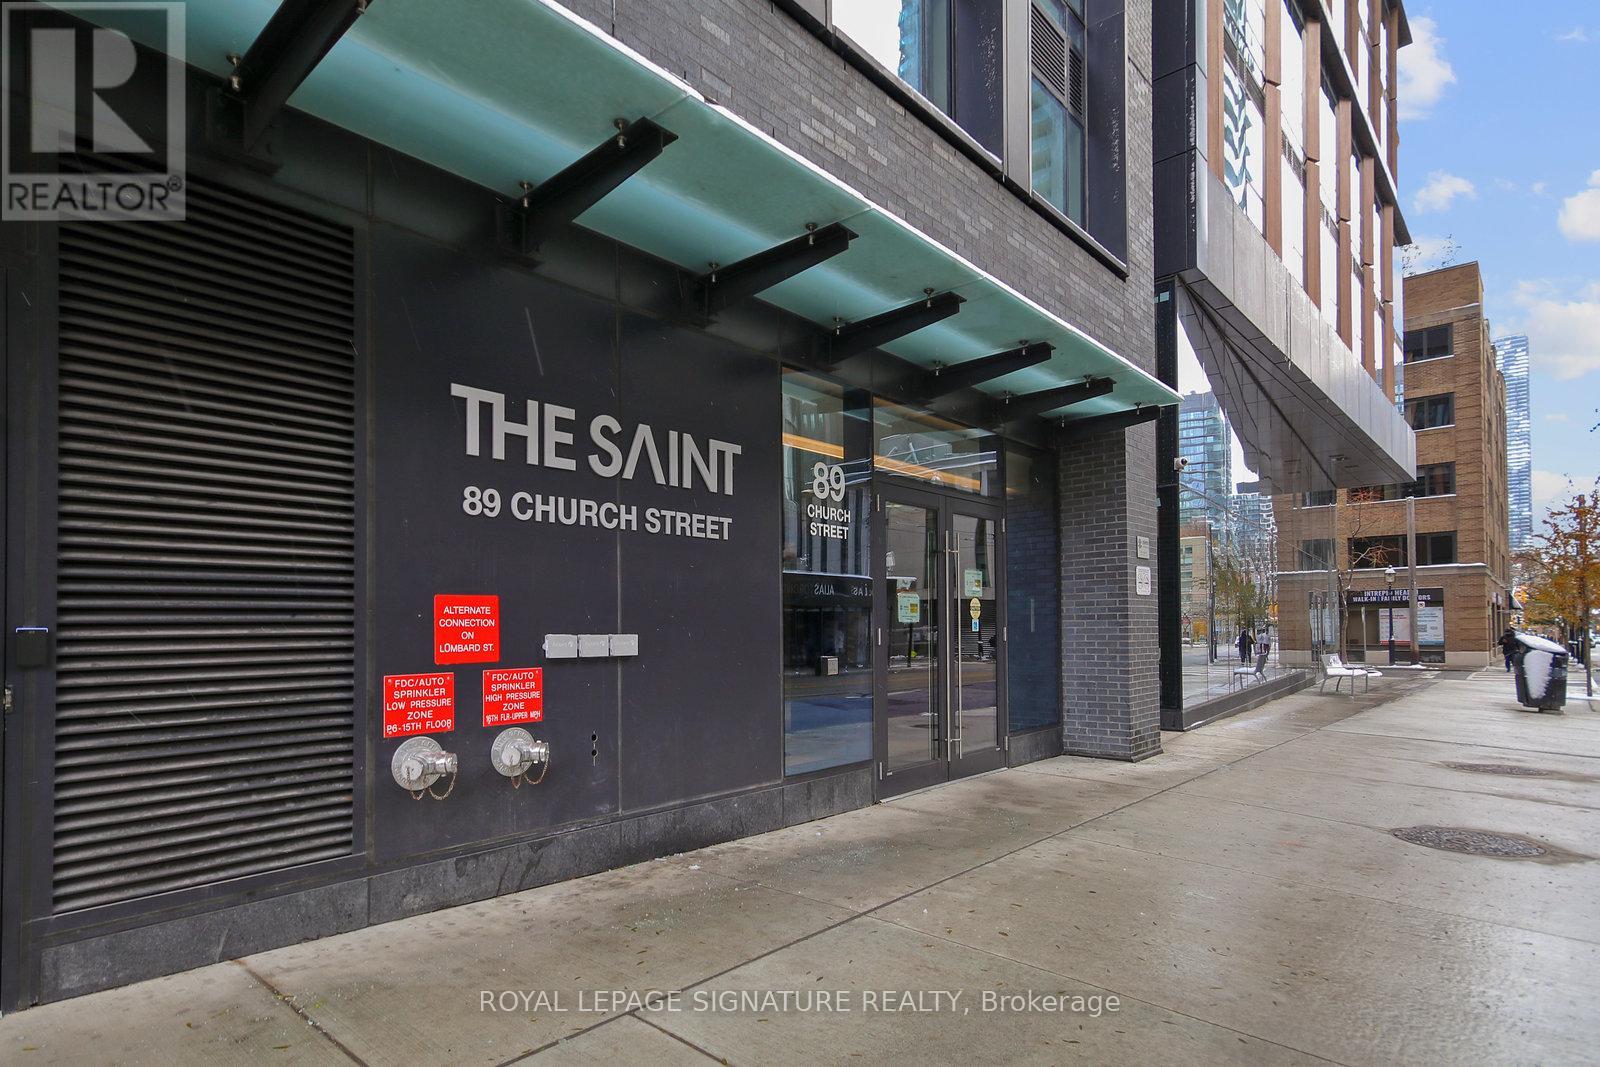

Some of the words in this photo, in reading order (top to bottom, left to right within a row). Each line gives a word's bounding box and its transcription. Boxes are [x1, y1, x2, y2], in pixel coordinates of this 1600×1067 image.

[450, 382, 577, 471] THE
[587, 414, 742, 496] SAINT
[812, 461, 846, 502] 89
[462, 485, 501, 518] 89
[510, 491, 638, 531] CHURCH
[644, 507, 733, 540] STREET
[807, 504, 851, 523] CHURCH
[810, 522, 849, 540] STREET
[443, 606, 491, 615] ALTERNATE
[439, 618, 495, 627] CONNECTION
[461, 631, 475, 640] ON
[439, 643, 480, 653] LOMBARD
[482, 643, 495, 652] ST.
[492, 672, 534, 681] FDC/AUTO
[394, 677, 444, 688] FDC/AUTO
[491, 682, 536, 692] SPRINKLER
[393, 688, 446, 699] SPRINKLER
[485, 694, 503, 702] HIGH
[506, 691, 541, 701] PRESSURE
[386, 701, 406, 711] LOW
[410, 698, 452, 709] PRESSURE
[502, 702, 525, 711] ZONE
[407, 710, 433, 720] ZONE
[426, 719, 452, 730] FLOOR
